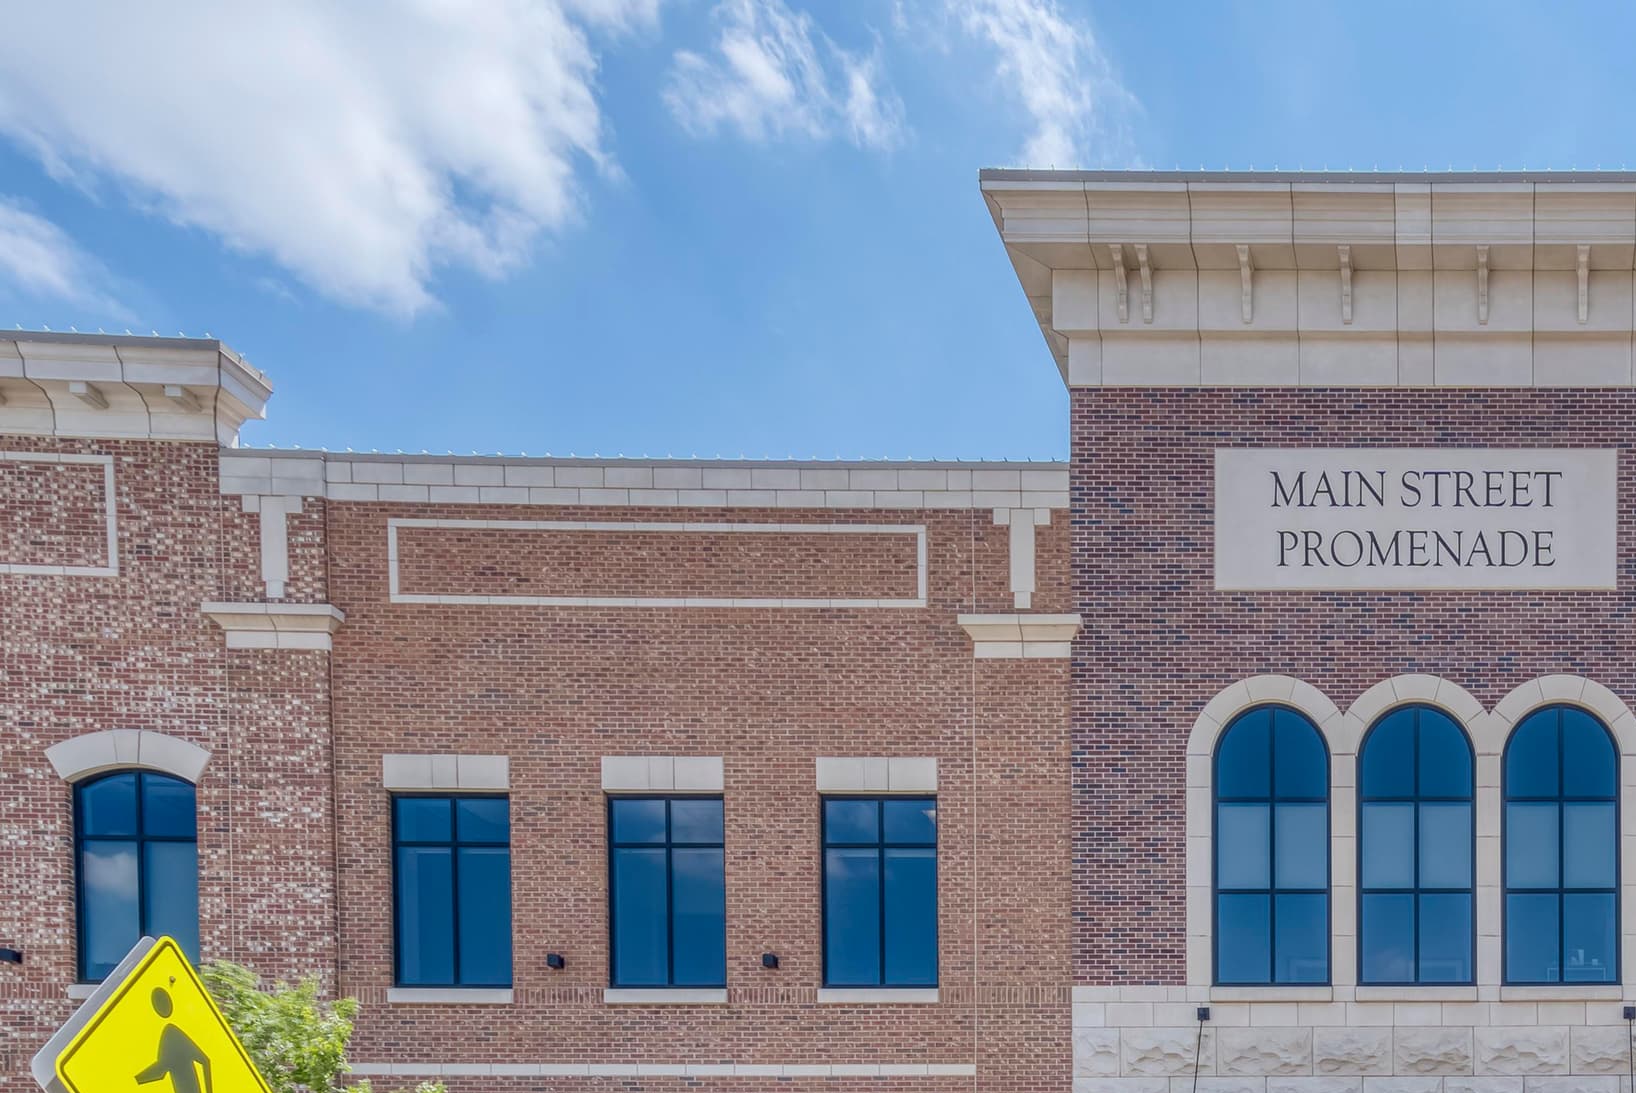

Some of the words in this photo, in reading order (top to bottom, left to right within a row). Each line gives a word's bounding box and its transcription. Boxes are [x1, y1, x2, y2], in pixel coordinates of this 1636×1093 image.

[1269, 470, 1386, 507] MAIN
[1400, 470, 1562, 507] STREET
[1276, 530, 1556, 567] PROMENADE
